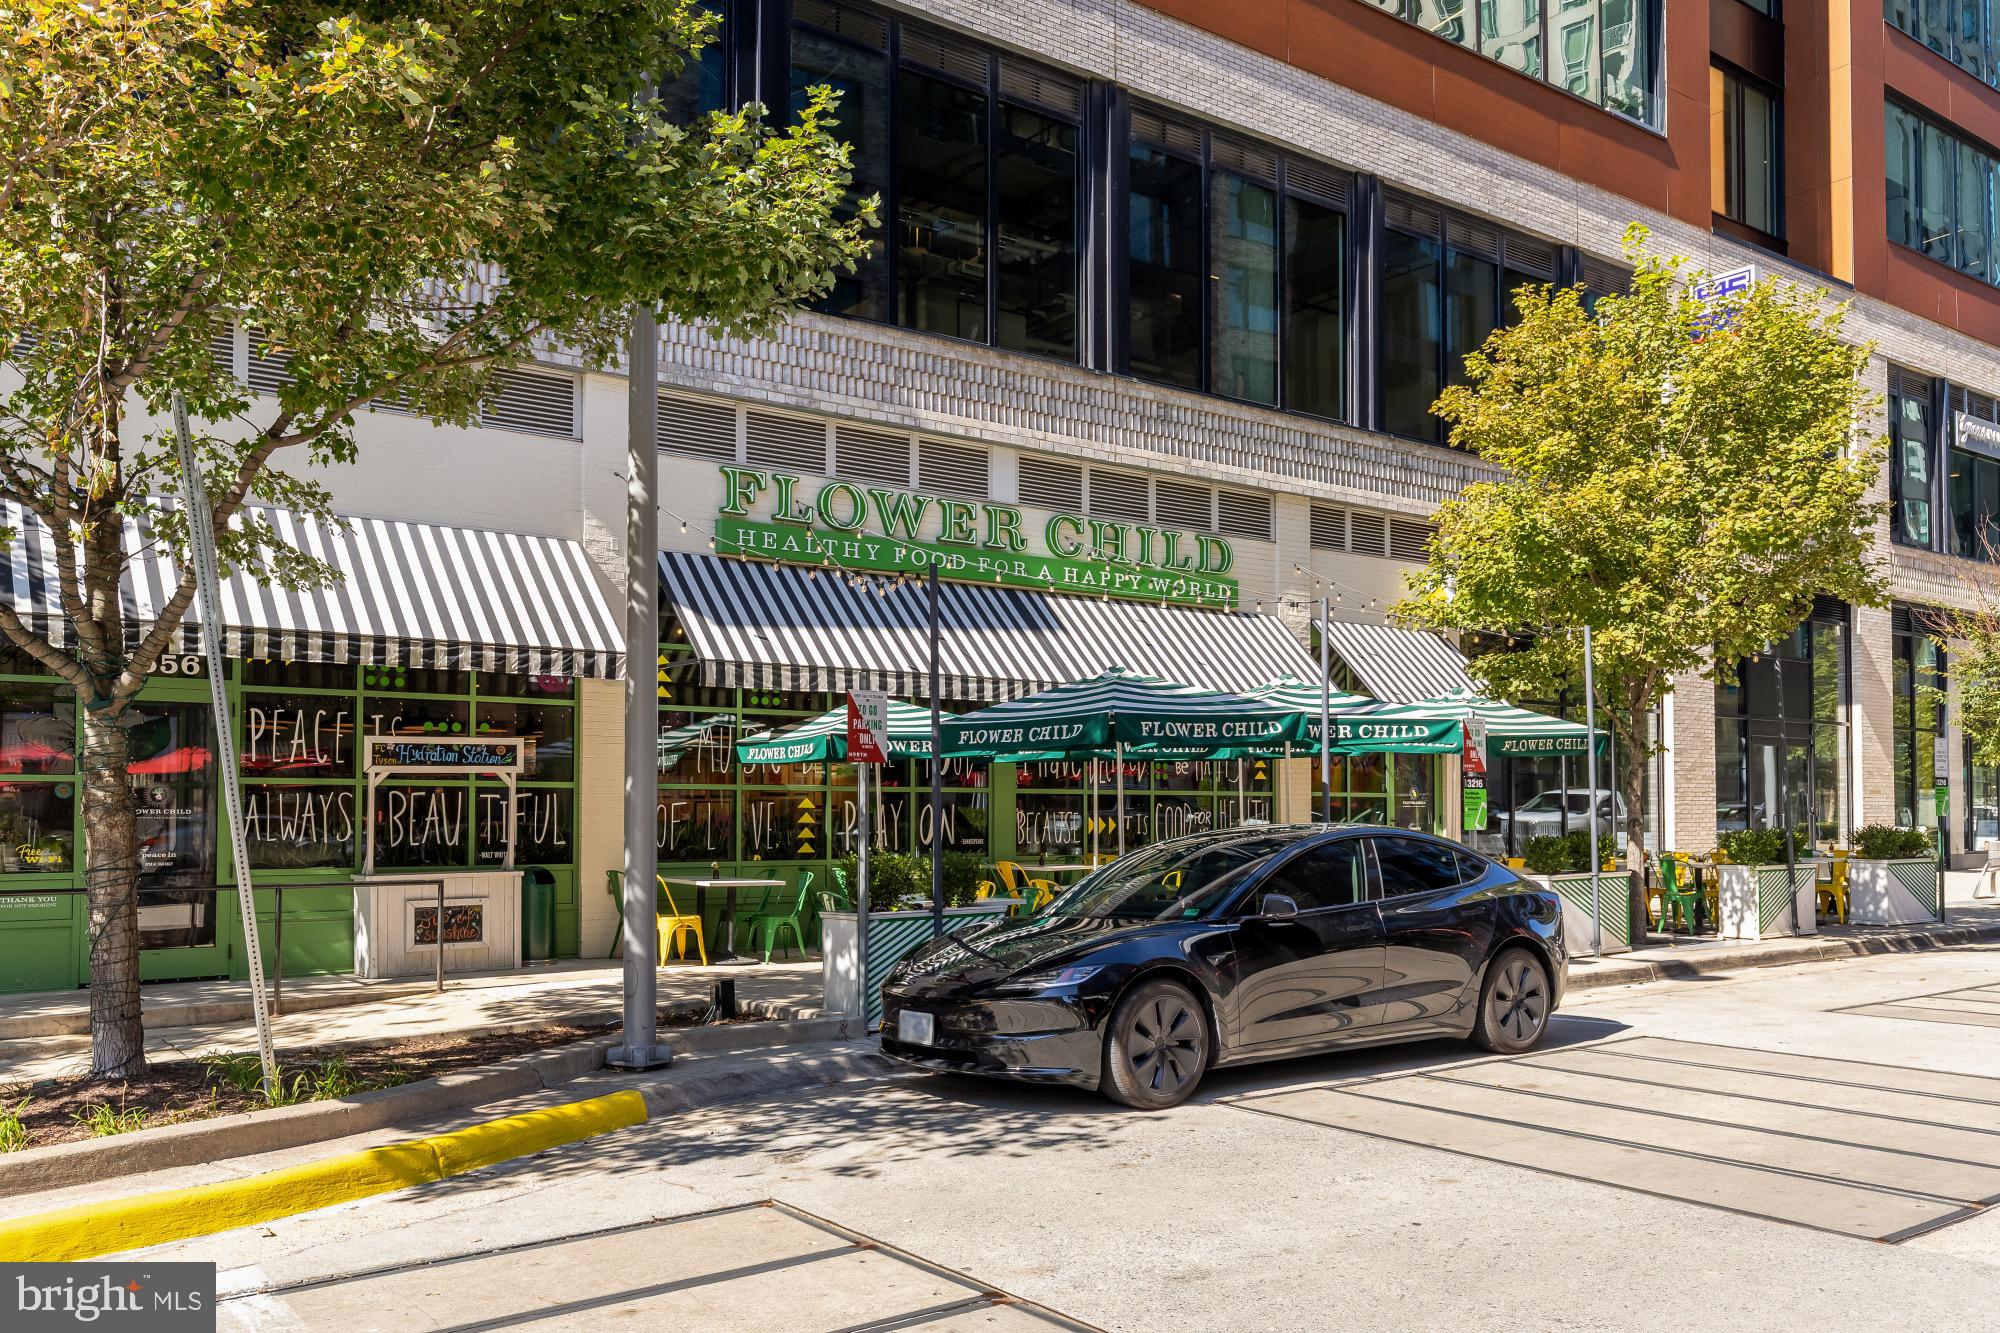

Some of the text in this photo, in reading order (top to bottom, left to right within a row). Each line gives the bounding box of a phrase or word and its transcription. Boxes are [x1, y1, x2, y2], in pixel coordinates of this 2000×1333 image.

[719, 465, 1235, 575] FLOWER CHILD
[736, 528, 1233, 600] HEALTHY FOOD FOR A HAPPY WORLD
[858, 704, 878, 716] TO GO
[853, 718, 883, 731] PARKING
[1140, 721, 1283, 738] FLOWER CHILD
[1358, 724, 1430, 739] CHILD
[250, 708, 348, 763] PEACE
[859, 733, 876, 745] ONLY
[957, 723, 1084, 745] FLOWER CHILD
[747, 744, 786, 760] FLOWER
[1501, 738, 1554, 752] FLOWER
[396, 744, 502, 764] Hydration Station
[1467, 779, 1483, 788] 3216
[244, 791, 352, 843] ALWAYS
[1016, 809, 1081, 845] BECAUSE
[1194, 811, 1213, 825] FOR
[16, 844, 42, 859] Free
